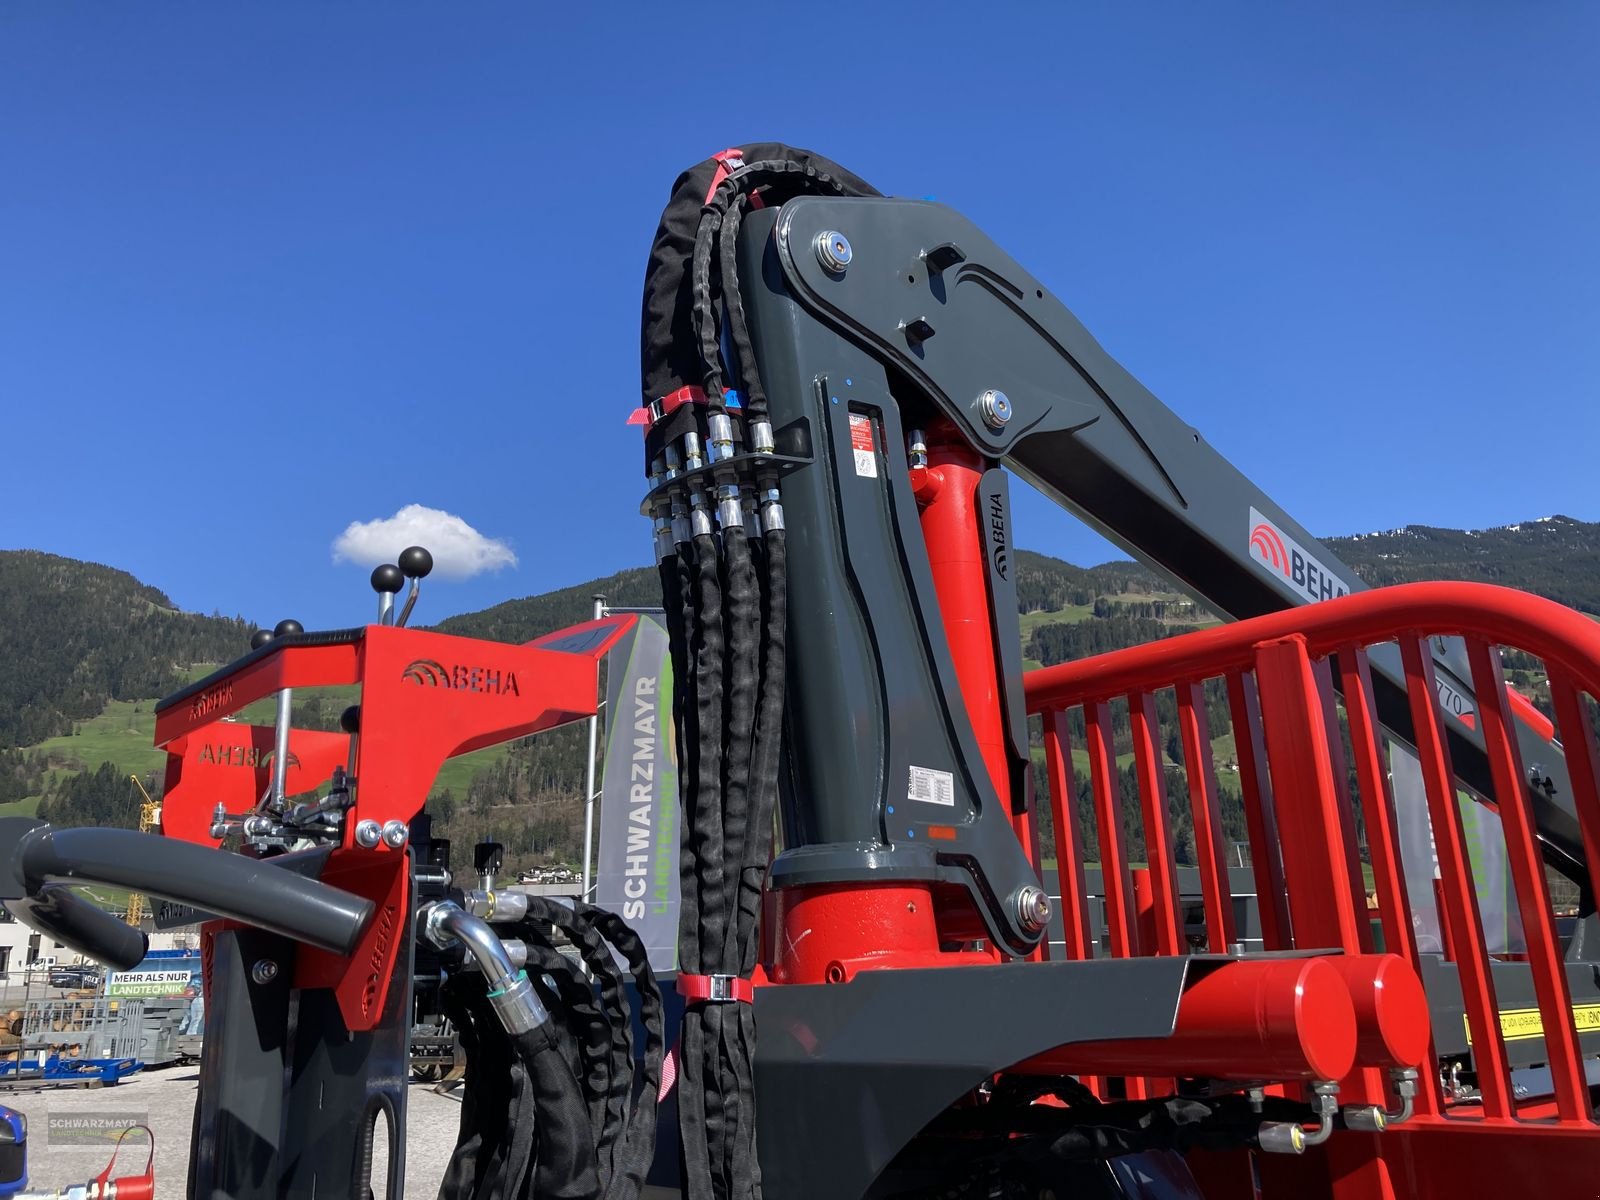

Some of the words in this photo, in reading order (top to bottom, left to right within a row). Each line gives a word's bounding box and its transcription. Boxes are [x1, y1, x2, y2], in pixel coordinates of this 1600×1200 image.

[990, 493, 1005, 544] BEHA
[452, 664, 520, 697] BEHA
[623, 676, 657, 920] SCHWARZMAYR
[654, 771, 675, 915] LANDTECHNIK
[371, 905, 396, 974] BEHA
[113, 984, 183, 995] LANDTECHNIK
[114, 973, 143, 983] MEHR
[144, 973, 164, 982] ALS
[166, 972, 188, 981] NUR
